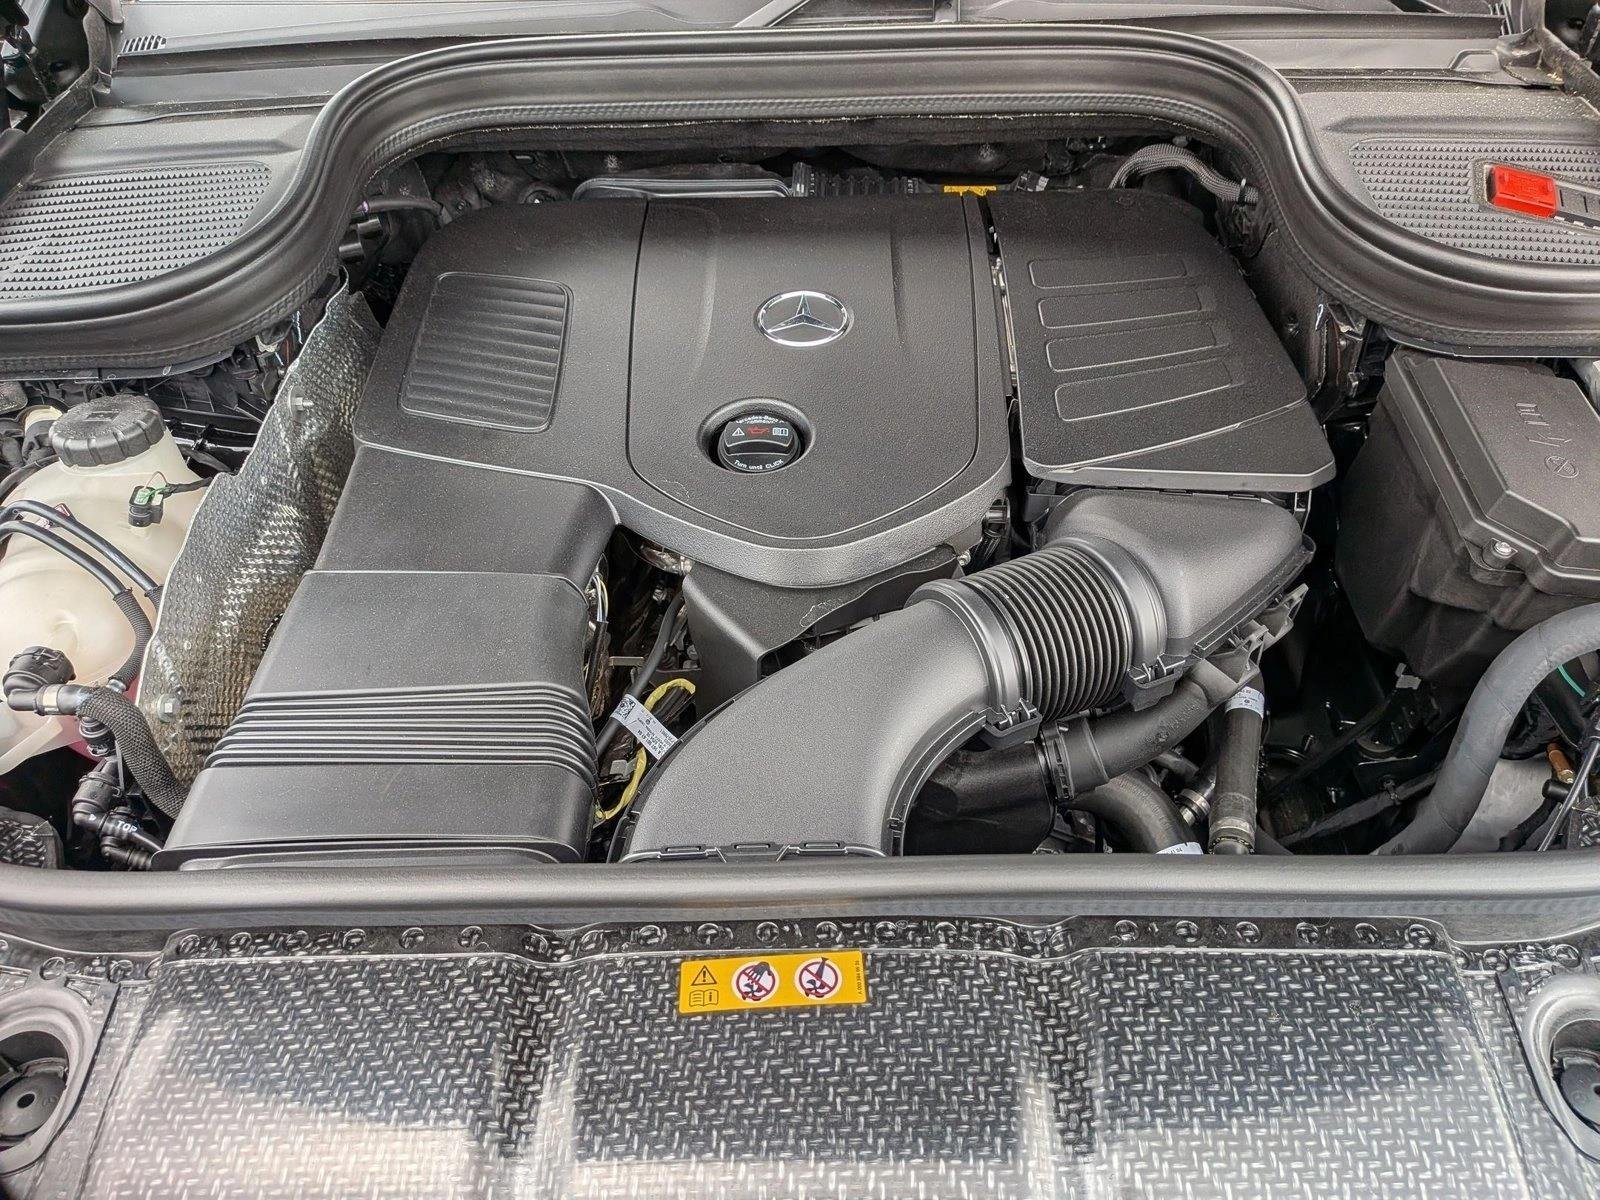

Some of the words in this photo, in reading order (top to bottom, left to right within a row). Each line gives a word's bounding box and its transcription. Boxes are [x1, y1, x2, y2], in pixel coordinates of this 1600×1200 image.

[734, 459, 748, 469] Turn
[765, 458, 784, 469] CLICK
[117, 820, 138, 833] TOP
